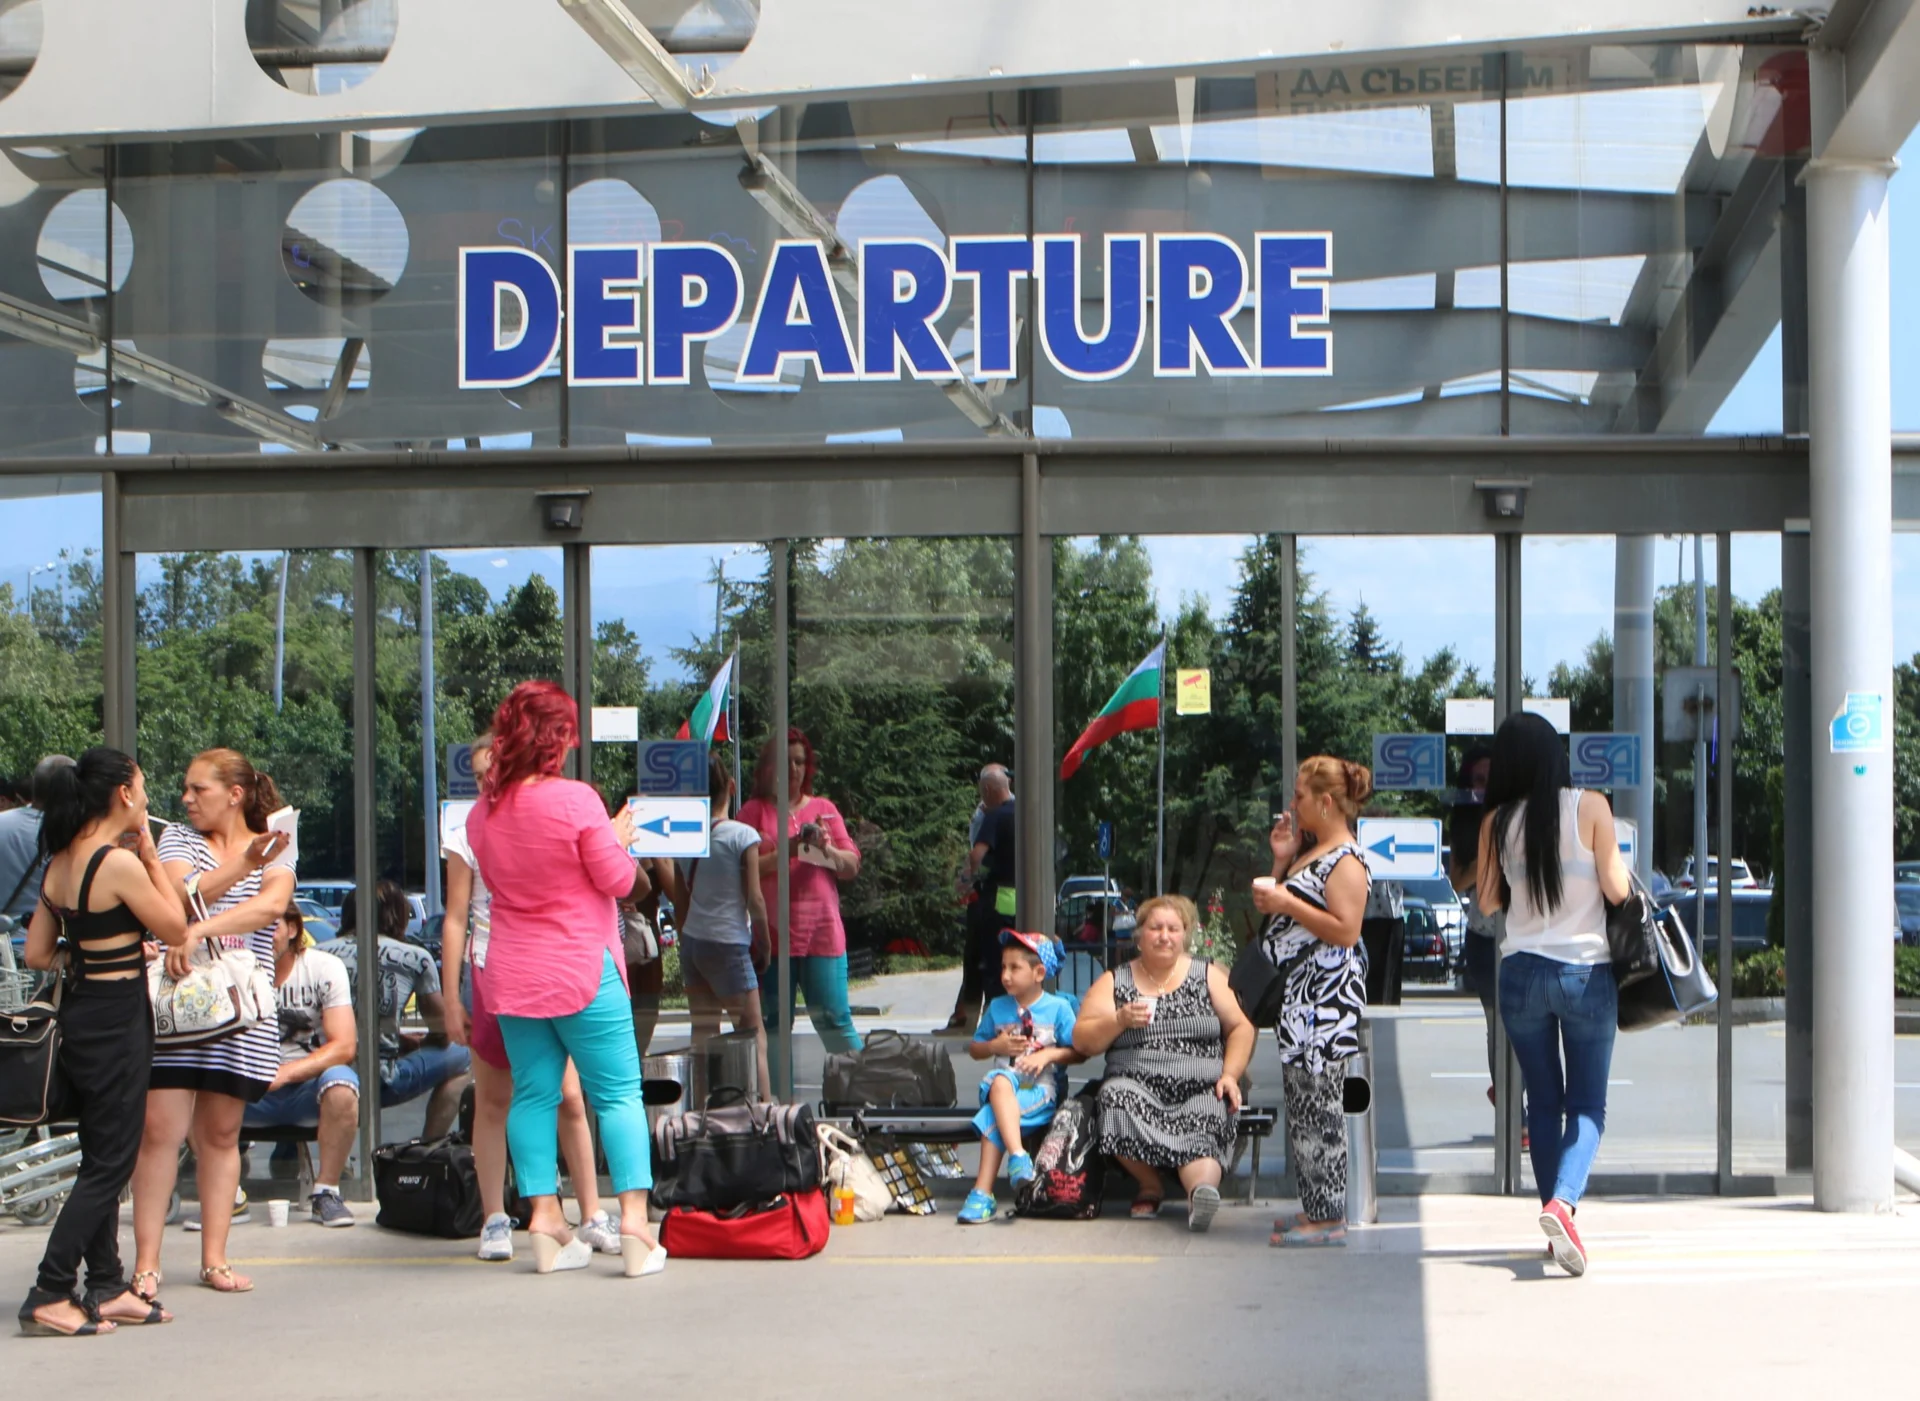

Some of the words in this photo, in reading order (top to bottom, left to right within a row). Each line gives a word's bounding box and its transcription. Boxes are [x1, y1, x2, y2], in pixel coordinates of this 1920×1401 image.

[1290, 67, 1351, 97] ДА
[1360, 65, 1554, 94] СЪБЕРМ
[458, 230, 1334, 390] DEPARTURE
